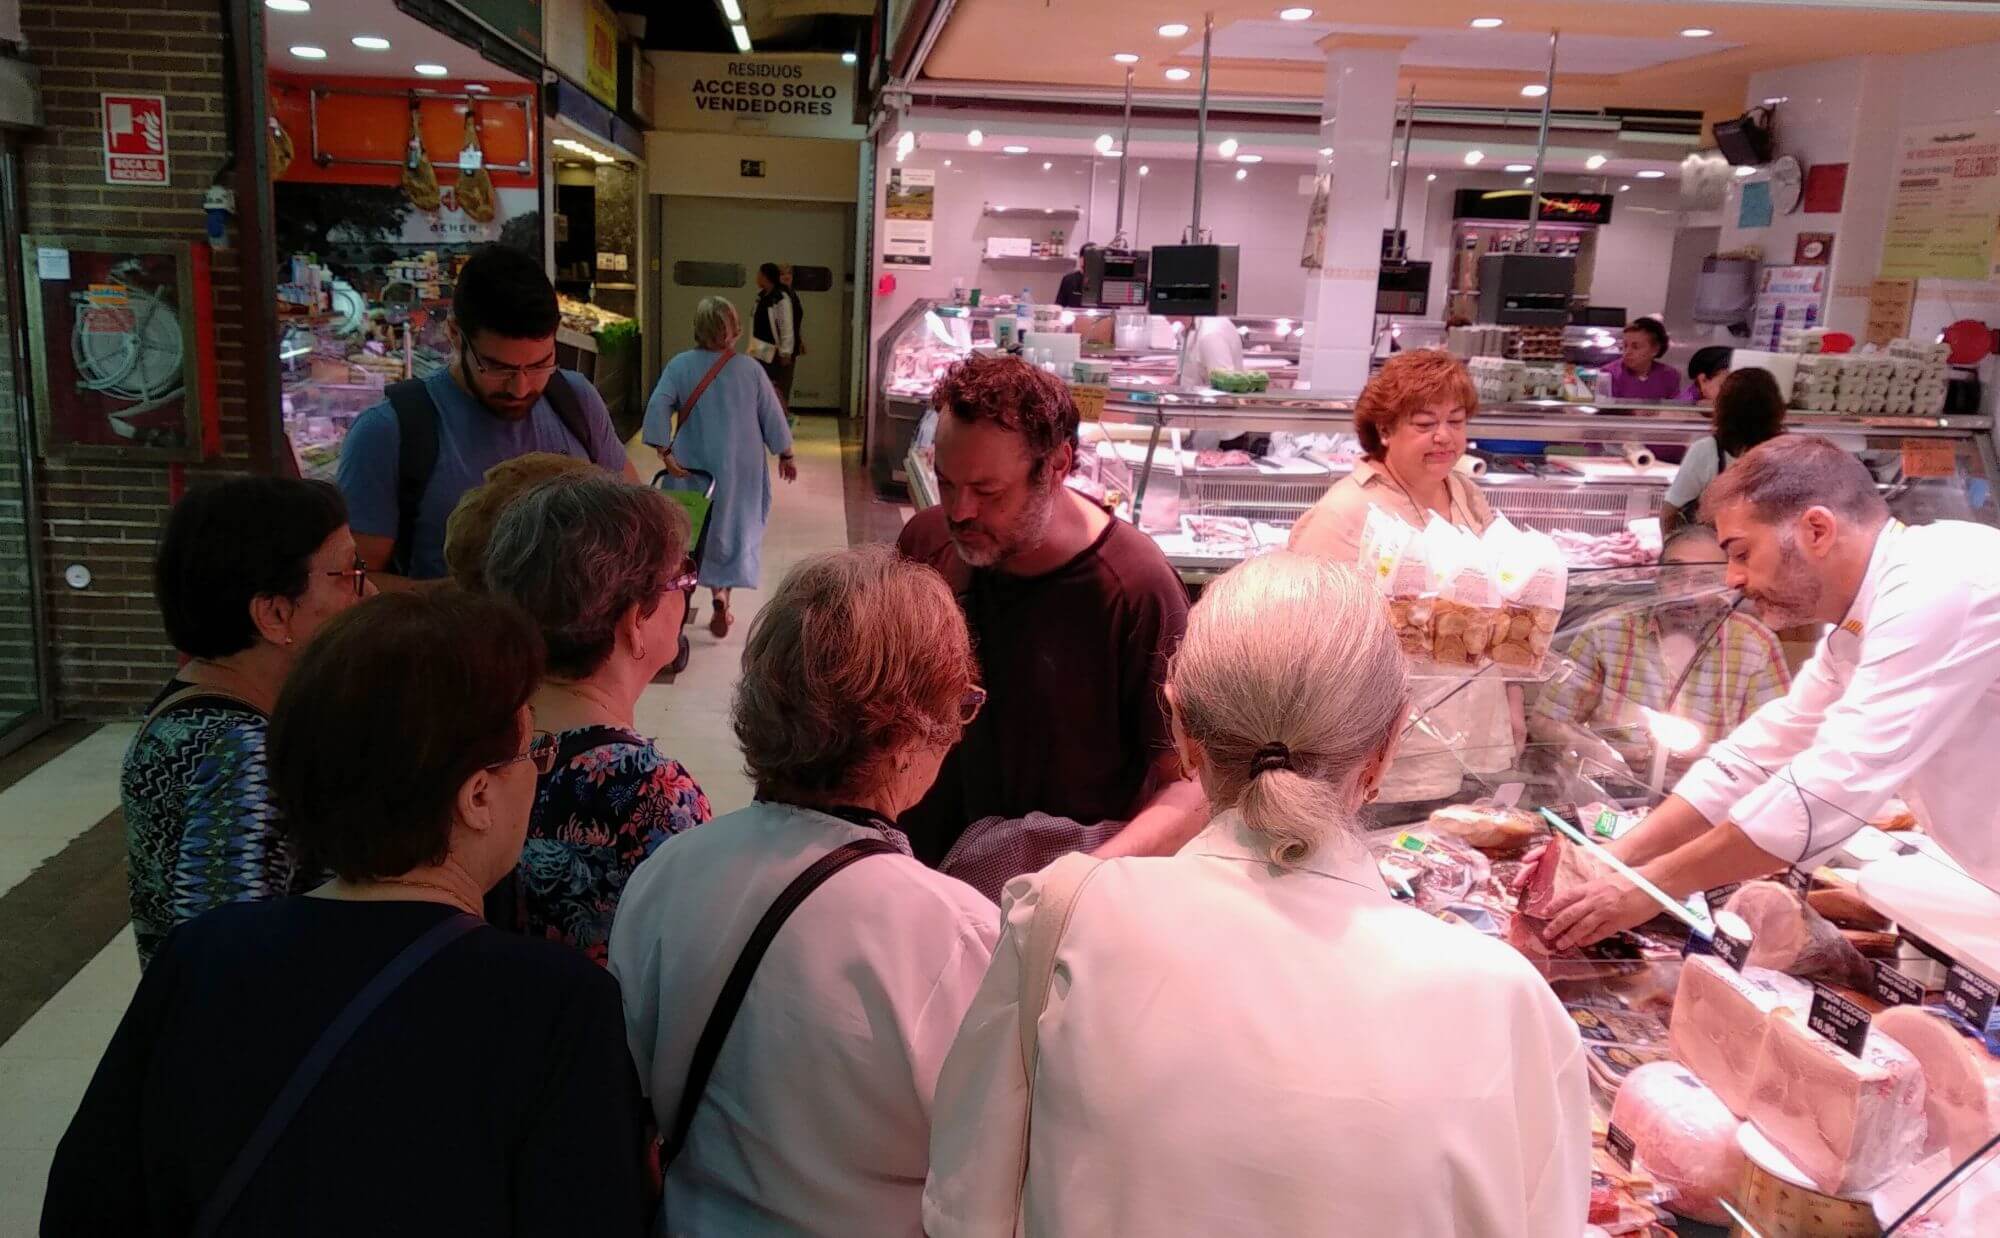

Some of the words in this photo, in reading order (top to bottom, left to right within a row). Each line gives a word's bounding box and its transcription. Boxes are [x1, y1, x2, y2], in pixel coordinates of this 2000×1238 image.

[727, 62, 802, 79] RESIDUOS
[692, 79, 776, 97] ACCESO
[782, 83, 836, 99] SOLO
[695, 96, 833, 115] VENDEDORES
[114, 158, 143, 169] BOCA
[145, 160, 159, 170] DE
[1822, 1001, 1841, 1018] LATA
[1841, 1000, 1870, 1023] COCIDO
